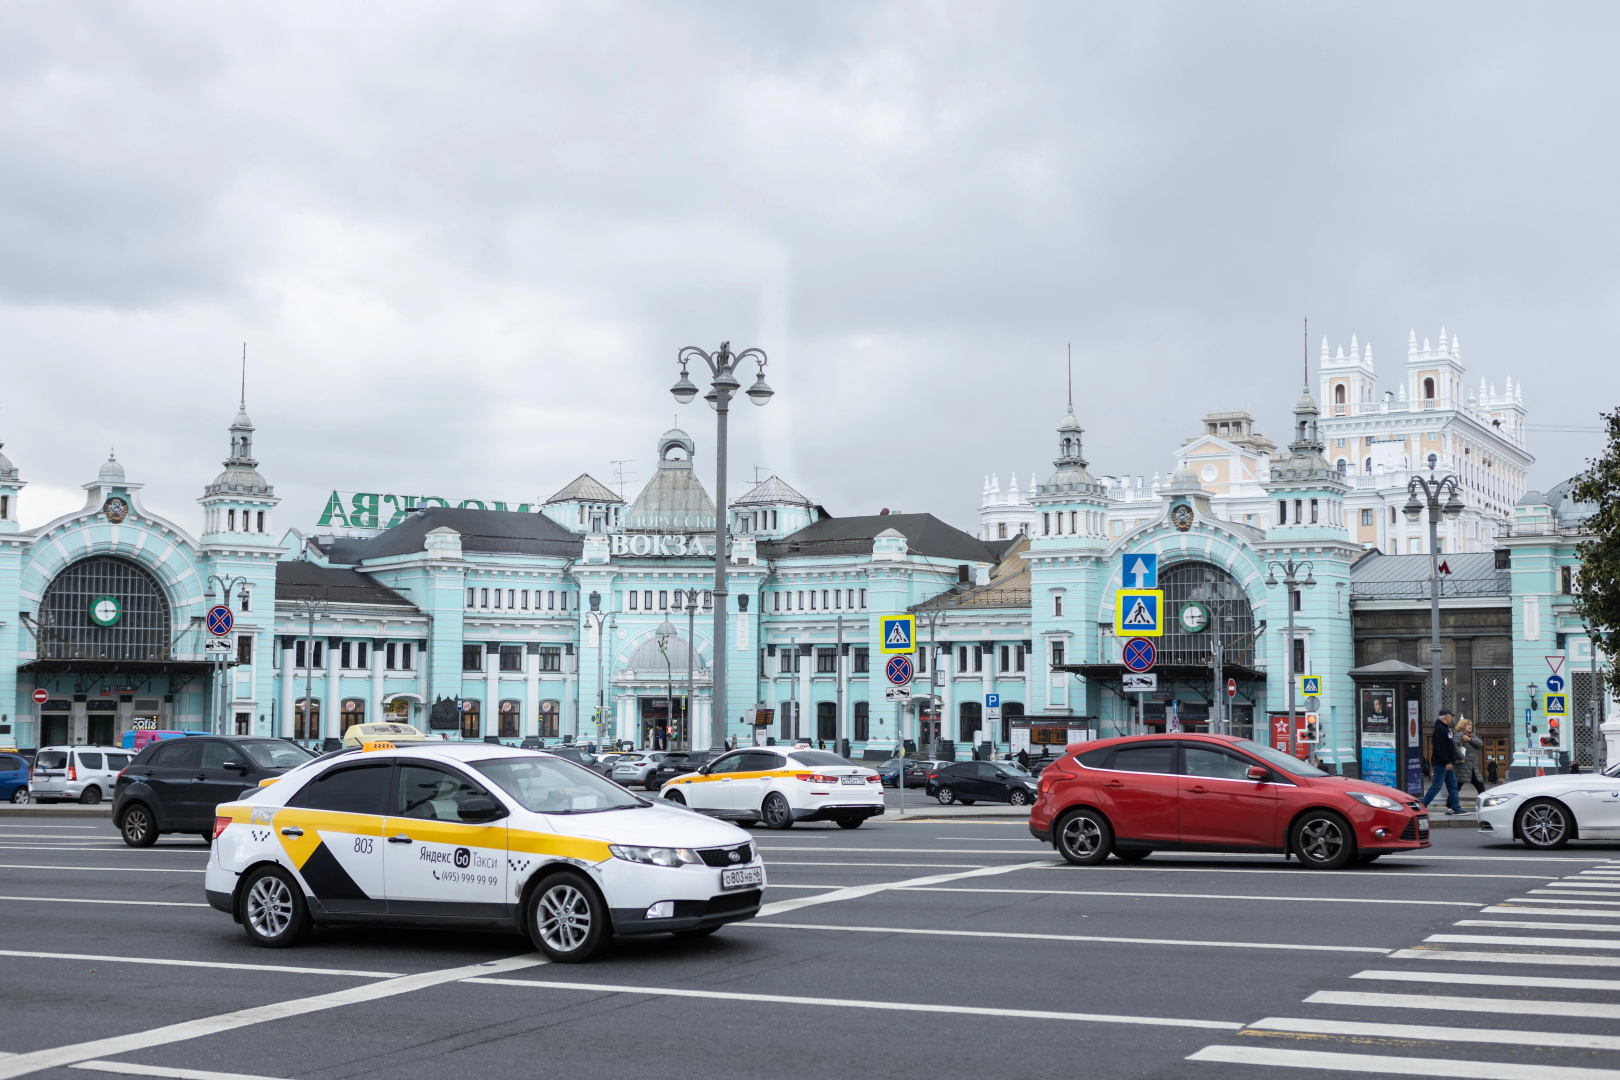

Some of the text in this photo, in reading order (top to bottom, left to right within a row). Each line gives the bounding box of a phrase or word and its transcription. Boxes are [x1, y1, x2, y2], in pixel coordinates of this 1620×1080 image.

[611, 515, 717, 528] БЕЛОРУССКИ
[989, 696, 997, 706] P
[354, 837, 374, 854] 803
[420, 846, 498, 869] Яндекс Go Такси
[441, 870, 498, 886] (495) 999 99 99
